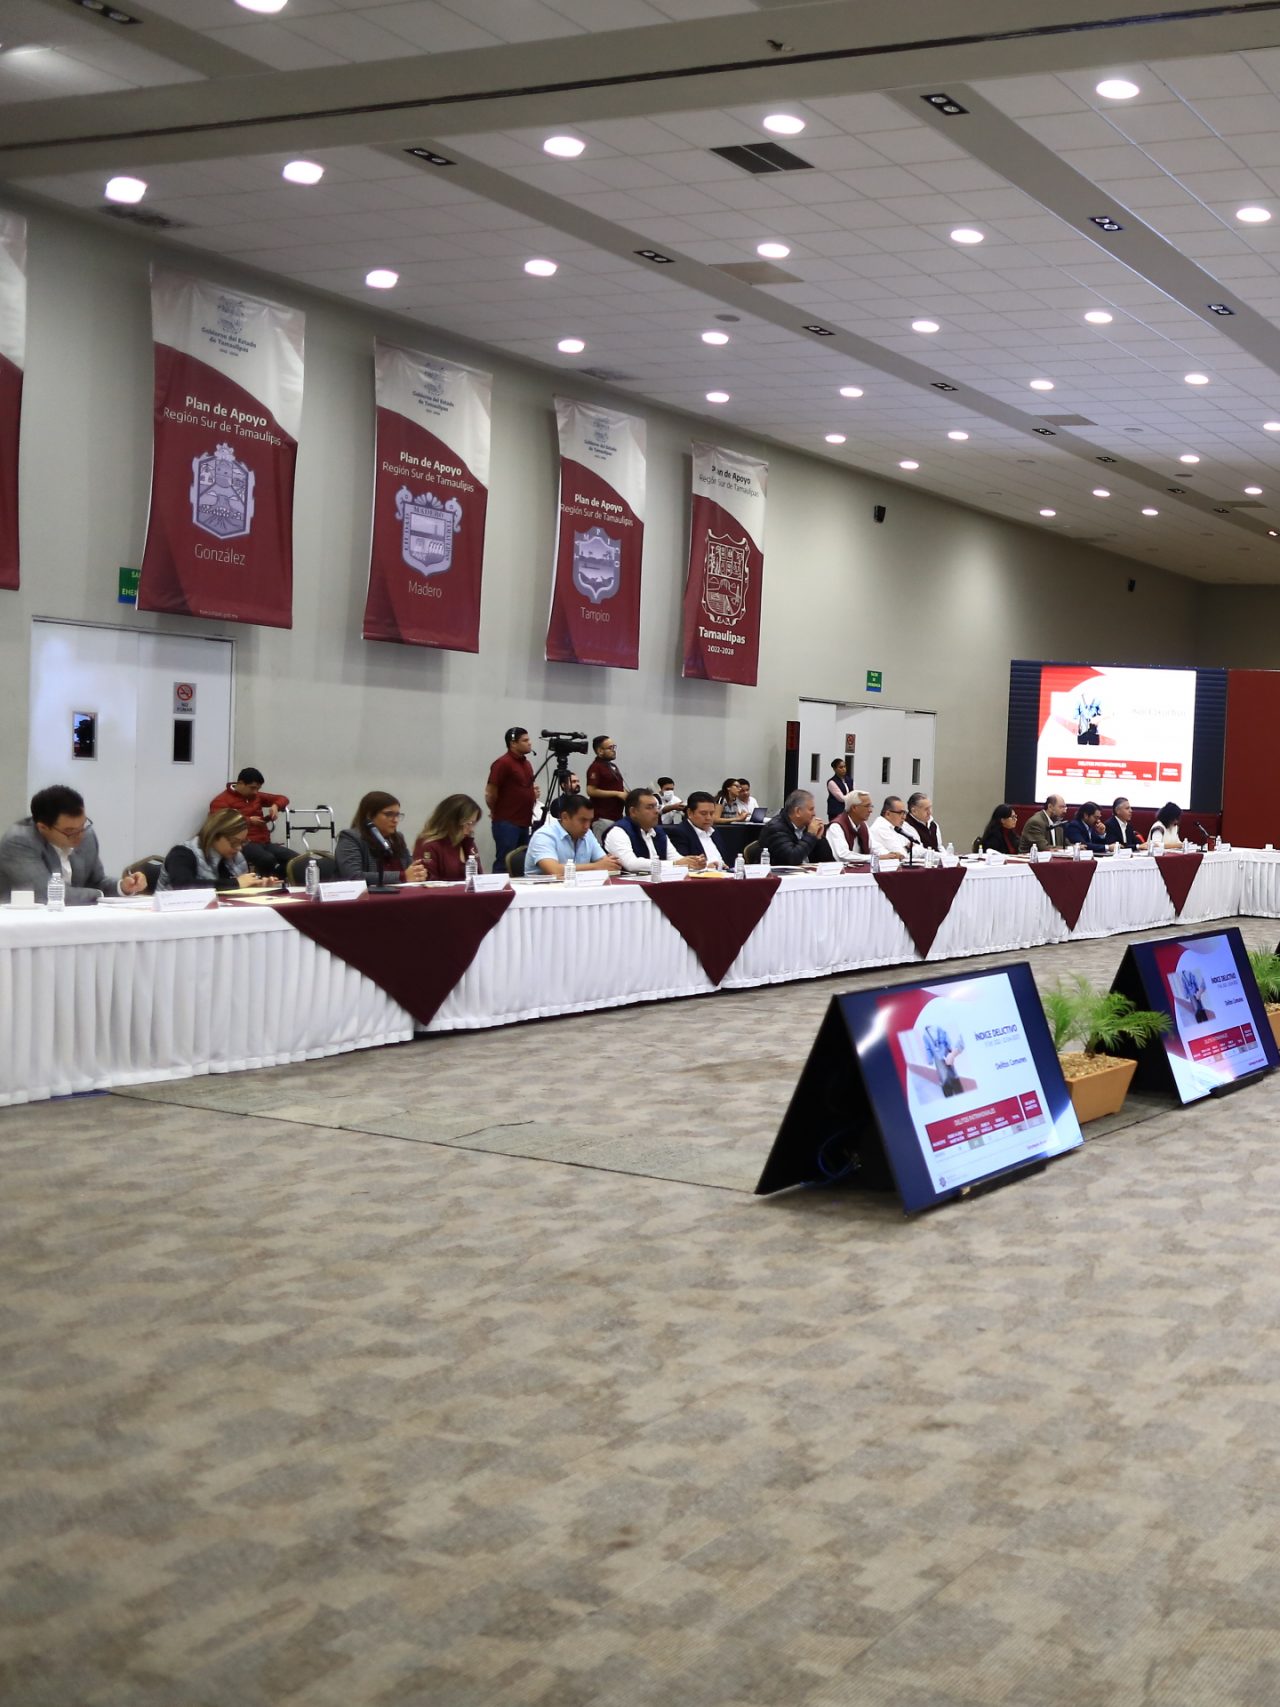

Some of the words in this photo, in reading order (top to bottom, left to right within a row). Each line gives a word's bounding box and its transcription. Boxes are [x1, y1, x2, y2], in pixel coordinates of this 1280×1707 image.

[185, 396, 211, 413] Plan
[213, 404, 228, 416] de
[230, 408, 268, 427] Apoyo
[163, 407, 199, 425] Región
[200, 416, 217, 429] Sur
[219, 421, 232, 433] de
[234, 424, 281, 446] Tamaulipas
[400, 451, 419, 465] Plan
[420, 457, 432, 468] de
[433, 461, 462, 477] Apoyo
[382, 461, 410, 476] Región
[411, 469, 424, 480] Sur
[425, 472, 435, 483] de
[436, 475, 475, 492] Tamaulipas
[723, 470, 731, 479] de
[732, 472, 751, 485] Apoyo
[574, 493, 590, 505] Plan
[590, 497, 600, 507] de
[601, 500, 623, 513] Apoyo
[583, 507, 594, 518] Sur
[594, 510, 602, 520] de
[603, 512, 634, 527] Tamaulipas
[194, 543, 246, 566] González
[408, 580, 443, 599] Madero
[580, 606, 611, 622] Tampico
[698, 626, 746, 645] Tamaulipas
